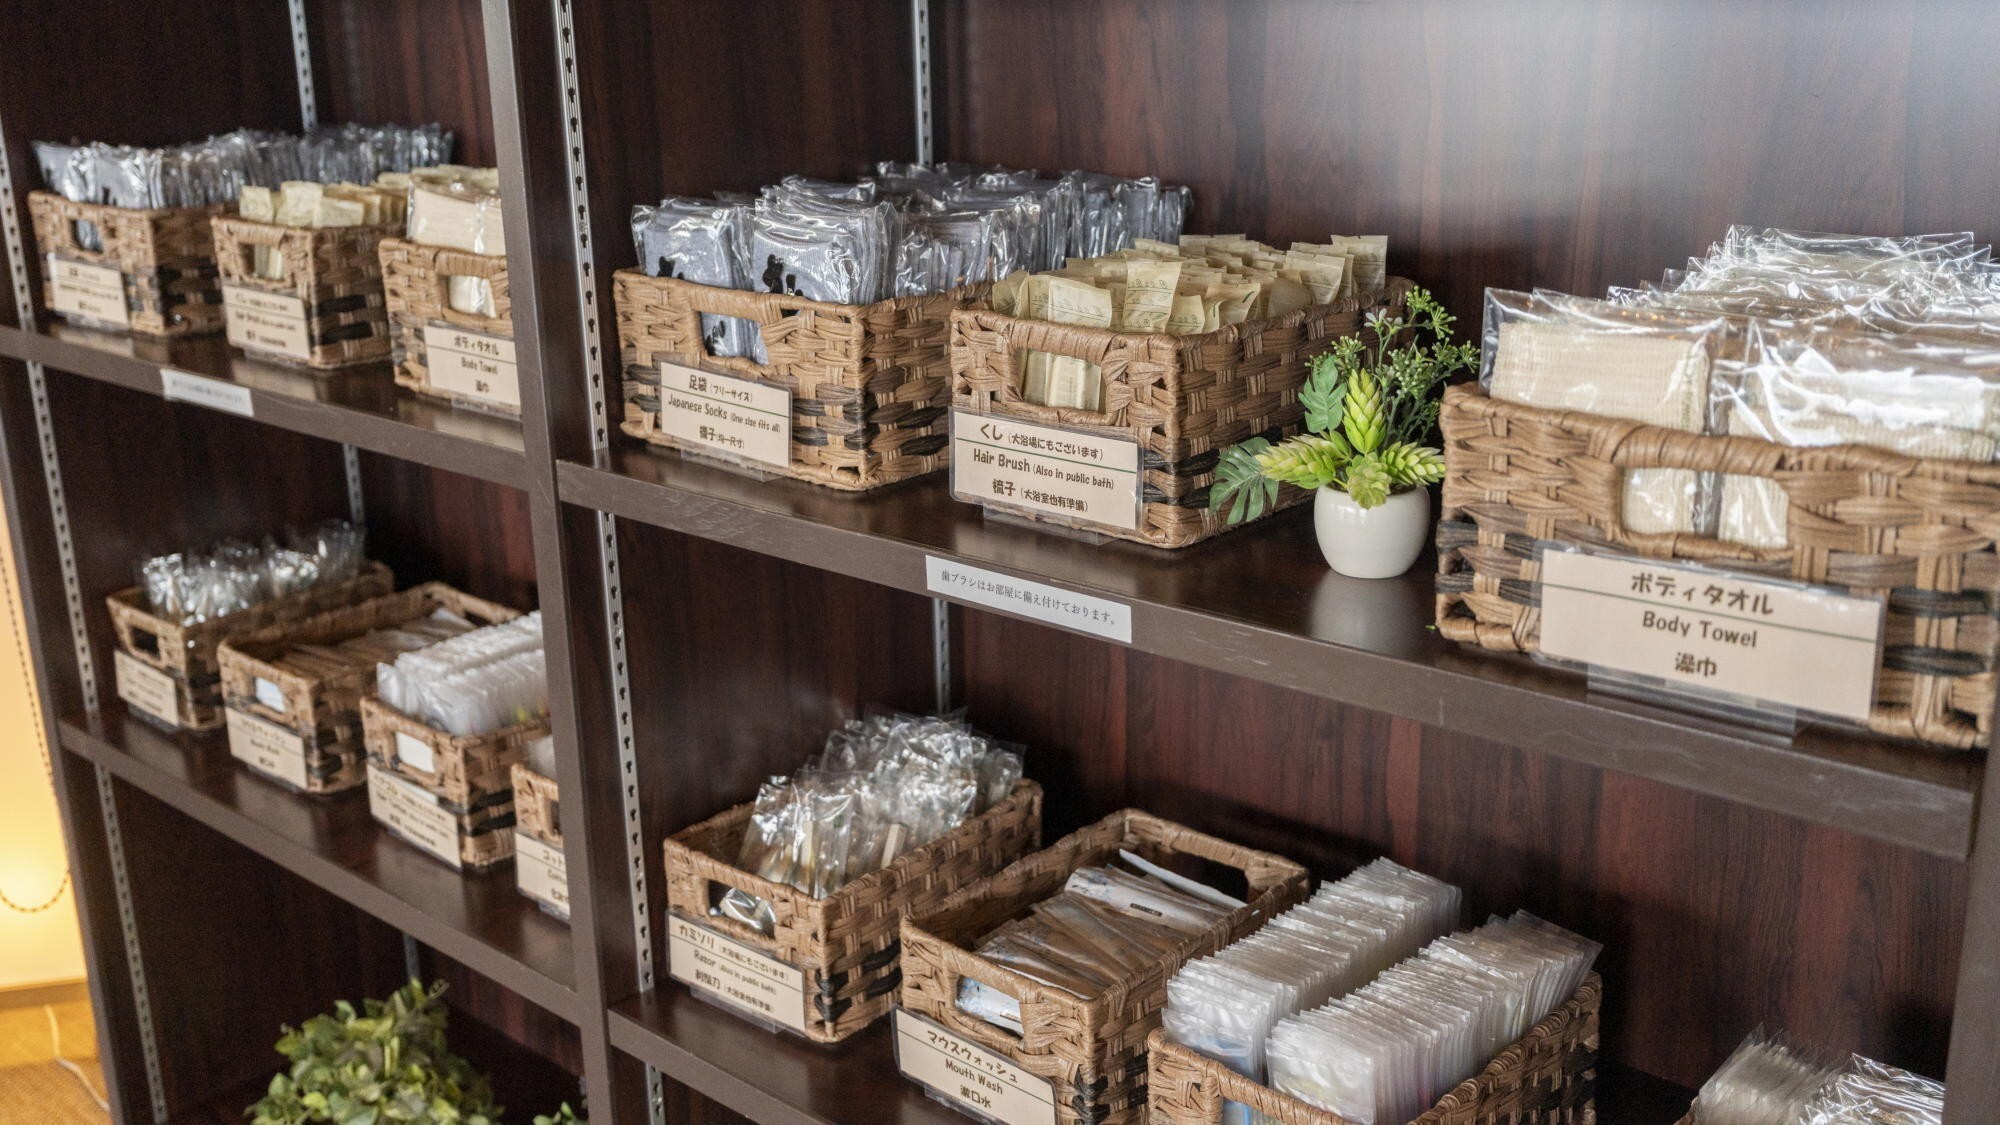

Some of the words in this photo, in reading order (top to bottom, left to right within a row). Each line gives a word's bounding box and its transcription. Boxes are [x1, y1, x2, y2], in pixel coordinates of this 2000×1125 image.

[688, 374, 708, 393] 足袋
[668, 394, 702, 413] Japanese
[705, 403, 728, 419] Socks
[980, 423, 1003, 441] くし
[1008, 433, 1104, 461] (大浴場にもございます)
[973, 448, 995, 465] Hair
[998, 453, 1030, 473] Brush
[1032, 464, 1053, 478] (Also
[1055, 467, 1064, 480] in
[1066, 471, 1090, 486] public
[1092, 475, 1115, 491] bath)
[992, 478, 1017, 497] 梳子
[941, 569, 1115, 625] 歯ブラシはお部屋に備え付けております。
[1631, 572, 1774, 616] ボディタオル
[1642, 611, 1691, 637] Body
[1700, 620, 1757, 648] Towel
[679, 925, 715, 949] カミソリ
[694, 949, 717, 966] Razor
[927, 1030, 1018, 1084] マウスウォッシュ
[945, 1058, 976, 1081] Mouth
[977, 1073, 1003, 1095] Wash
